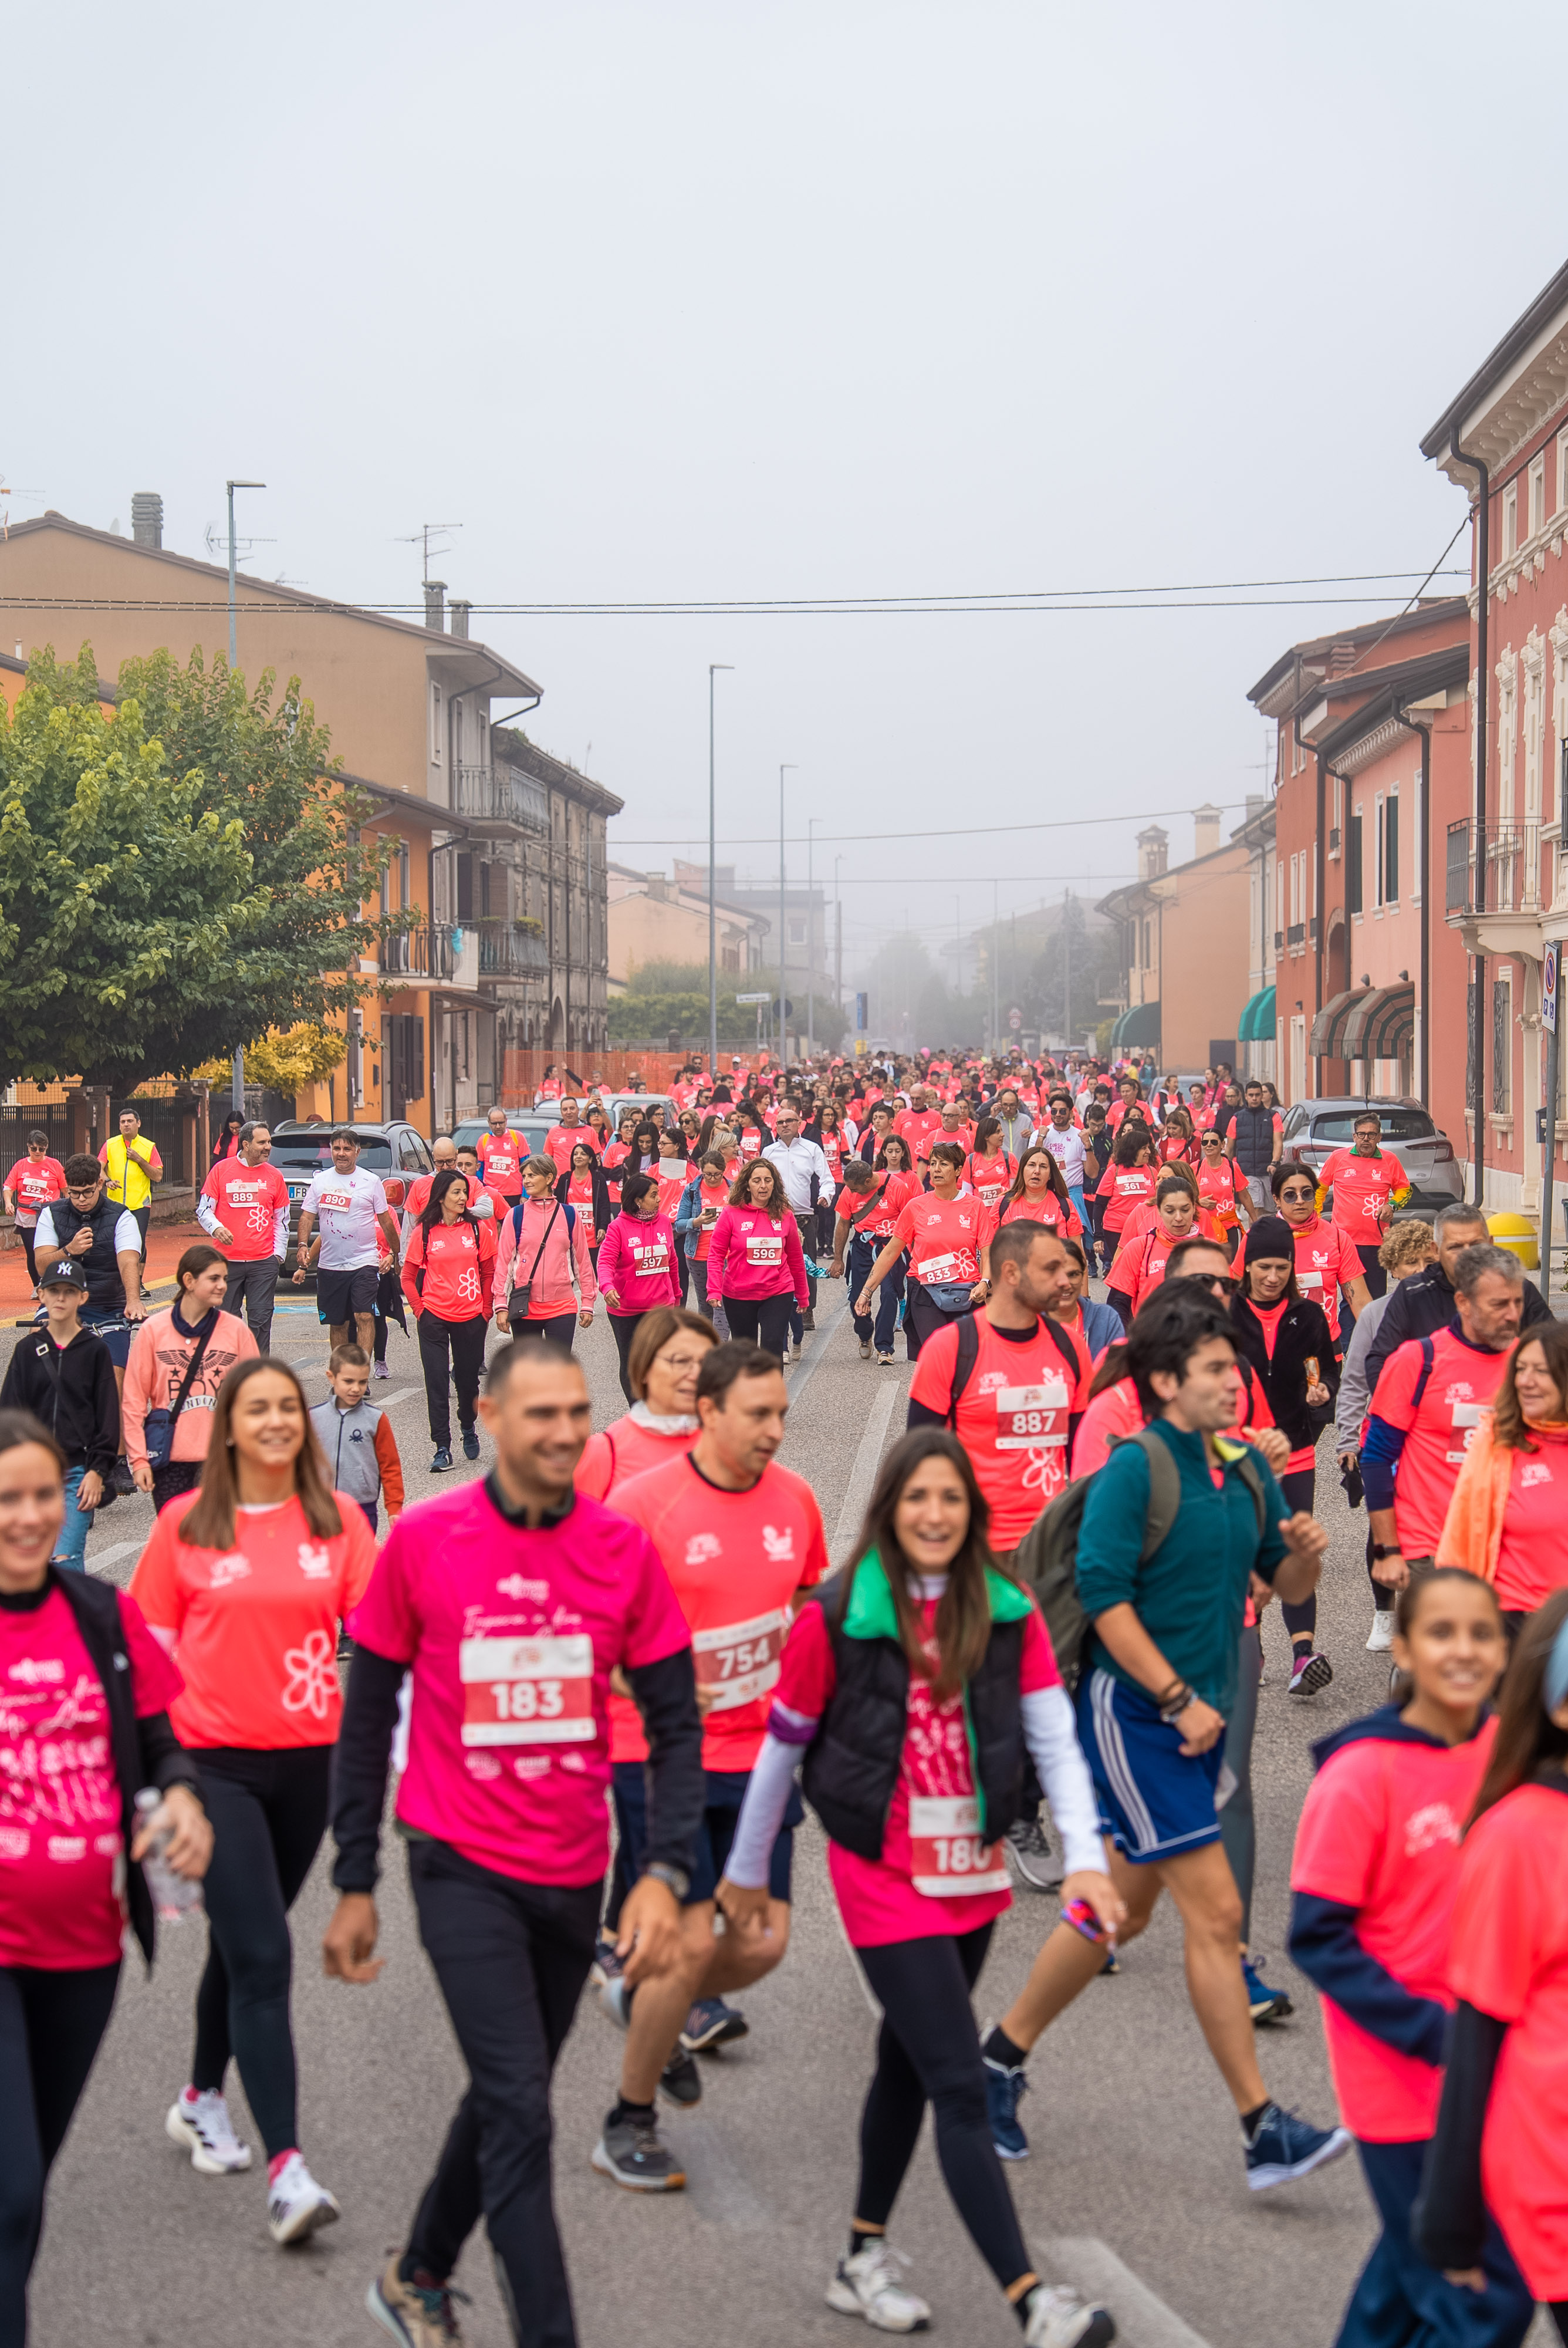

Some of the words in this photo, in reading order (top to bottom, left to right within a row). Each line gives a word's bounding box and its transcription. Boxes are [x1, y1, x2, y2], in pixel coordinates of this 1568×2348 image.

[26, 1185, 42, 1194] 622
[982, 1190, 998, 1199] 752
[232, 1193, 254, 1202] 889
[325, 1195, 346, 1206] 890
[752, 1249, 776, 1259] 596
[57, 1261, 73, 1276] NY
[642, 1256, 663, 1269] 597
[927, 1267, 951, 1283] 833
[1012, 1411, 1056, 1435] 887
[715, 1637, 770, 1679] 754
[490, 1680, 565, 1720] 183
